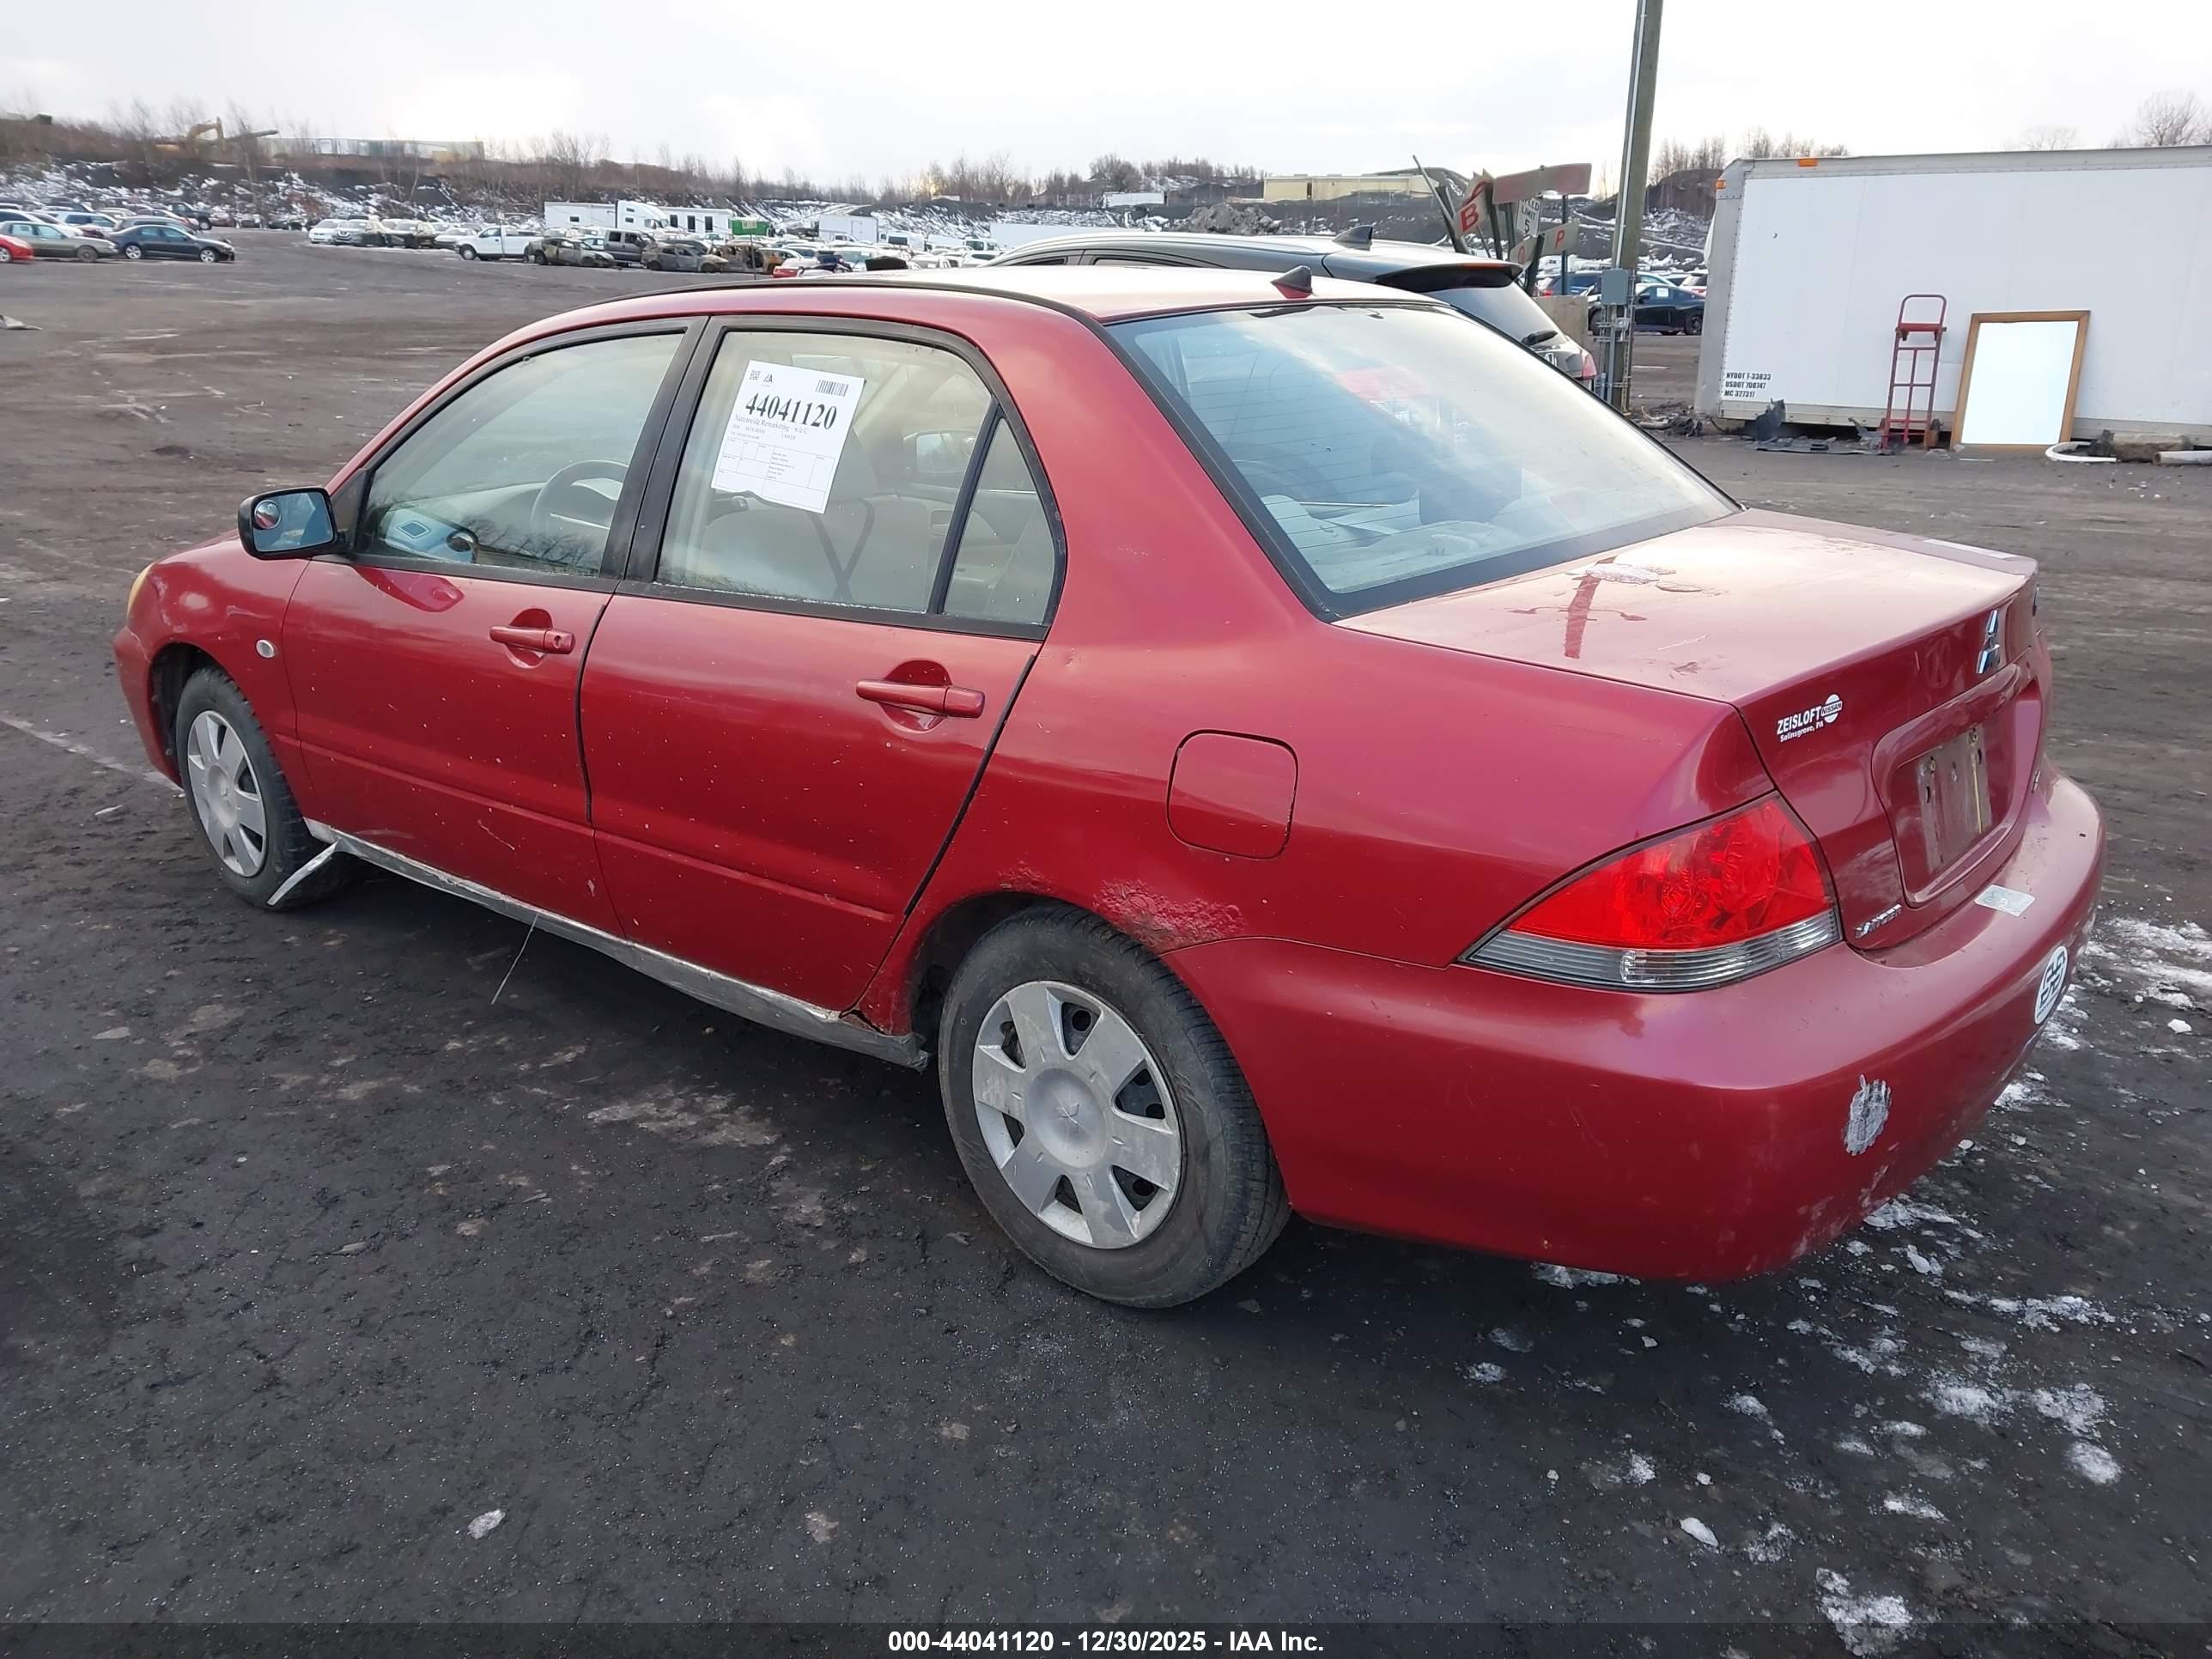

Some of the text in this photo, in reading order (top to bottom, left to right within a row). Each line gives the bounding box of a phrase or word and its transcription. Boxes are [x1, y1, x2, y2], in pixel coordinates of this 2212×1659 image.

[1461, 202, 1479, 232] B
[1522, 204, 1536, 221] LIMIT
[1524, 219, 1530, 234] 5
[1555, 229, 1565, 248] P
[745, 392, 837, 429] 44041120
[1777, 702, 1842, 735] ZEISLOFT NISSAN
